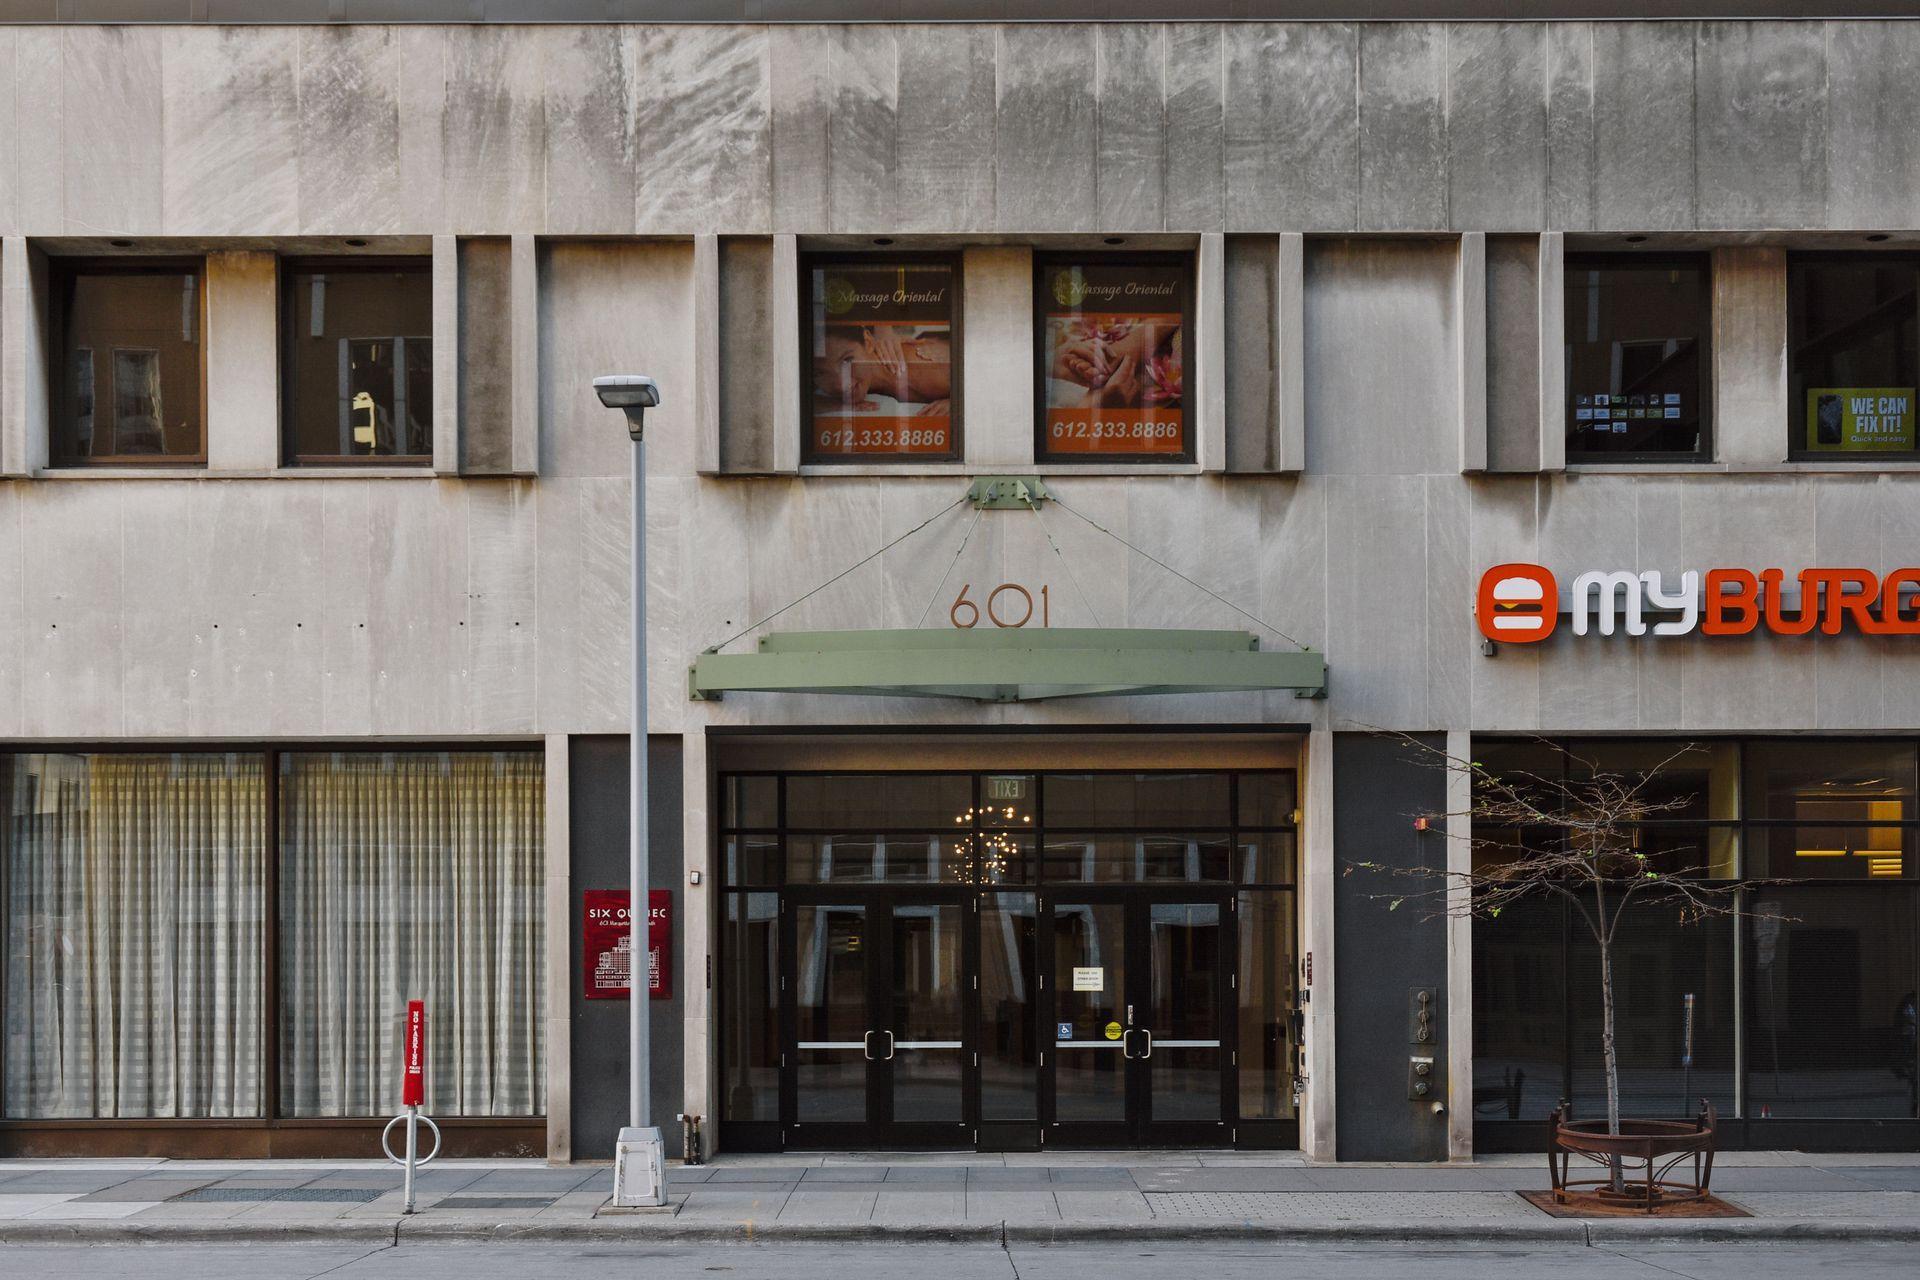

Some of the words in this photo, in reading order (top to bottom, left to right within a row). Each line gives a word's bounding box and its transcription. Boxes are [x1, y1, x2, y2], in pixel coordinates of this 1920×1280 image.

[837, 289, 890, 309] Massage
[895, 287, 945, 304] Oriental
[1070, 281, 1123, 302] Massage
[1124, 280, 1175, 296] Oriental
[1851, 397, 1874, 415] WE
[1878, 396, 1907, 415] CAN
[1052, 422, 1177, 439] 612.333.8886
[1855, 415, 1878, 433] FIX
[1882, 415, 1902, 433] IT!
[819, 429, 945, 447] 612.333.8886
[950, 583, 1048, 628] 601
[589, 908, 611, 918] SIX
[617, 908, 666, 919] QUEC
[412, 1011, 419, 1023] NO
